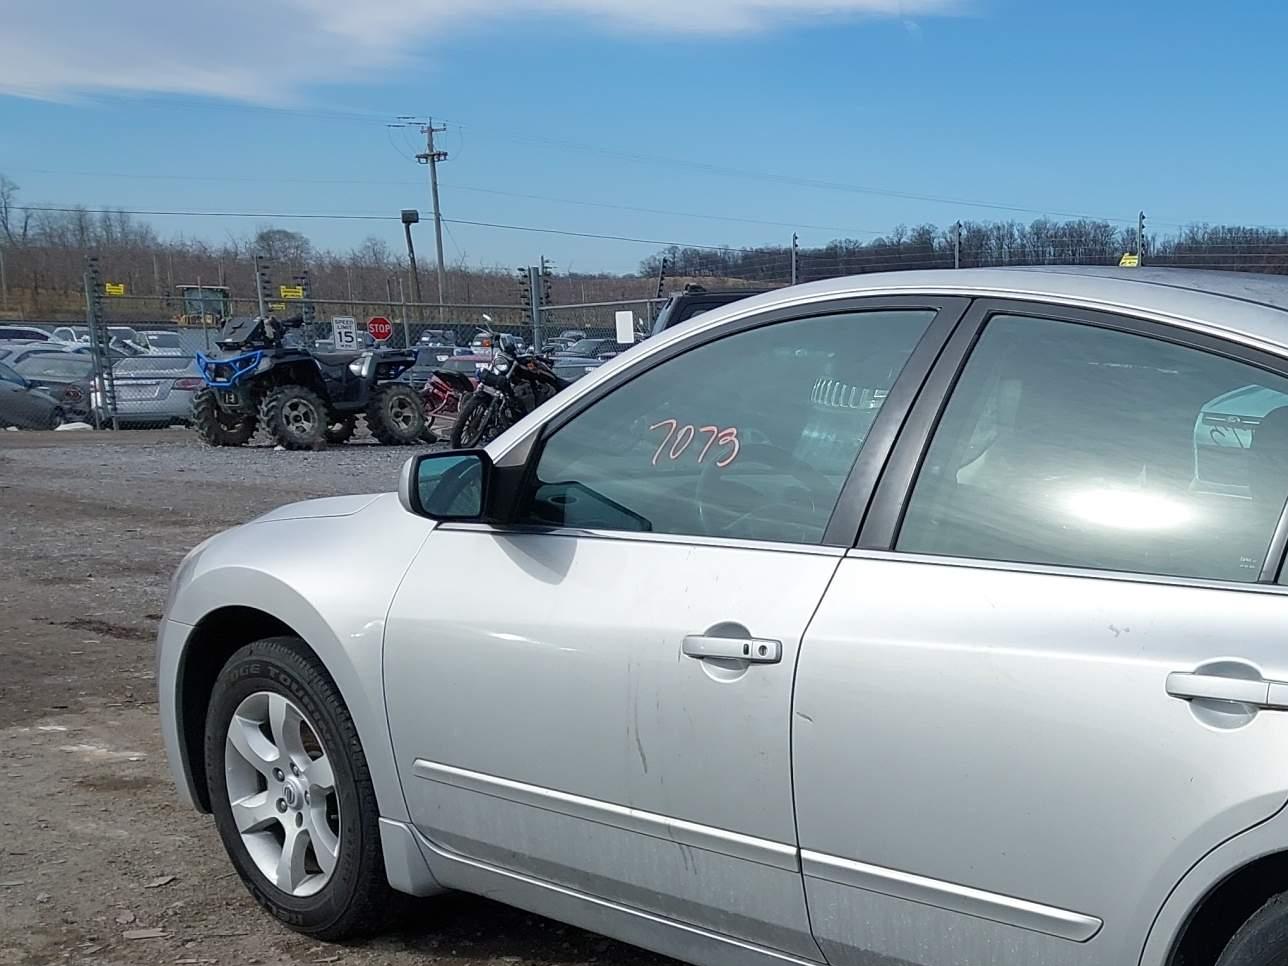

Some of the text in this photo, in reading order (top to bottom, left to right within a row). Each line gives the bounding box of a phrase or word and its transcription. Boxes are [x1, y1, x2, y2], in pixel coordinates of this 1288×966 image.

[370, 324, 391, 333] STOP
[338, 331, 354, 344] 15
[649, 418, 740, 468] 7073
